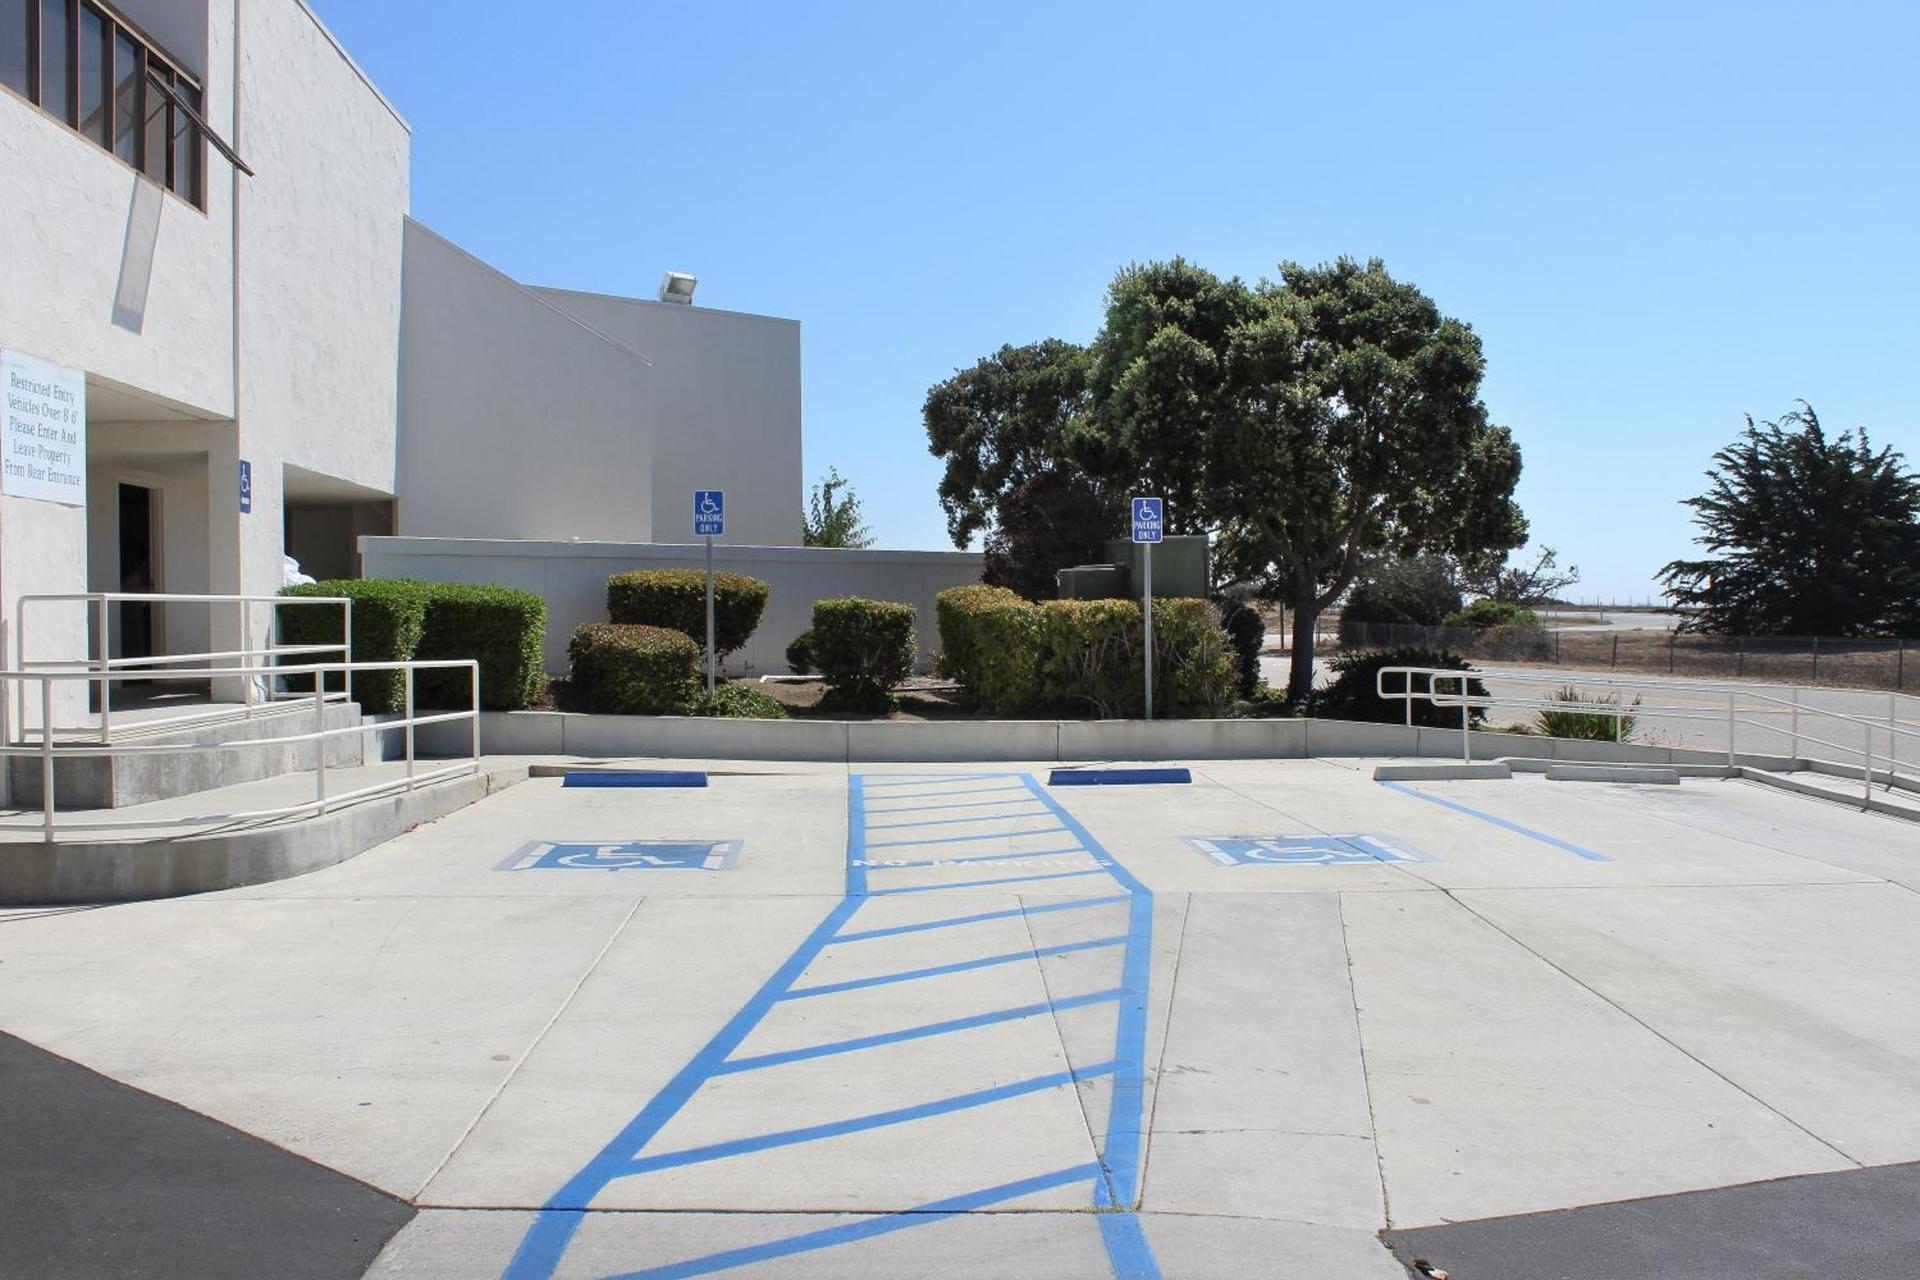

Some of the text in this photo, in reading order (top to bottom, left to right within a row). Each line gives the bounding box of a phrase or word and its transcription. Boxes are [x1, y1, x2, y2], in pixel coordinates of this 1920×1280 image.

[11, 372, 75, 403] Restricted Entry
[8, 392, 40, 416] Vehicles
[42, 403, 60, 421] Over
[10, 416, 76, 444] Please Enter And
[13, 439, 71, 467] Leave Property
[5, 459, 81, 486] From Rear Entrance
[696, 513, 722, 522] PARKING
[1134, 521, 1160, 530] PARKING
[700, 523, 717, 532] ONLY
[1139, 530, 1156, 540] ONLY
[852, 859, 907, 867] NO
